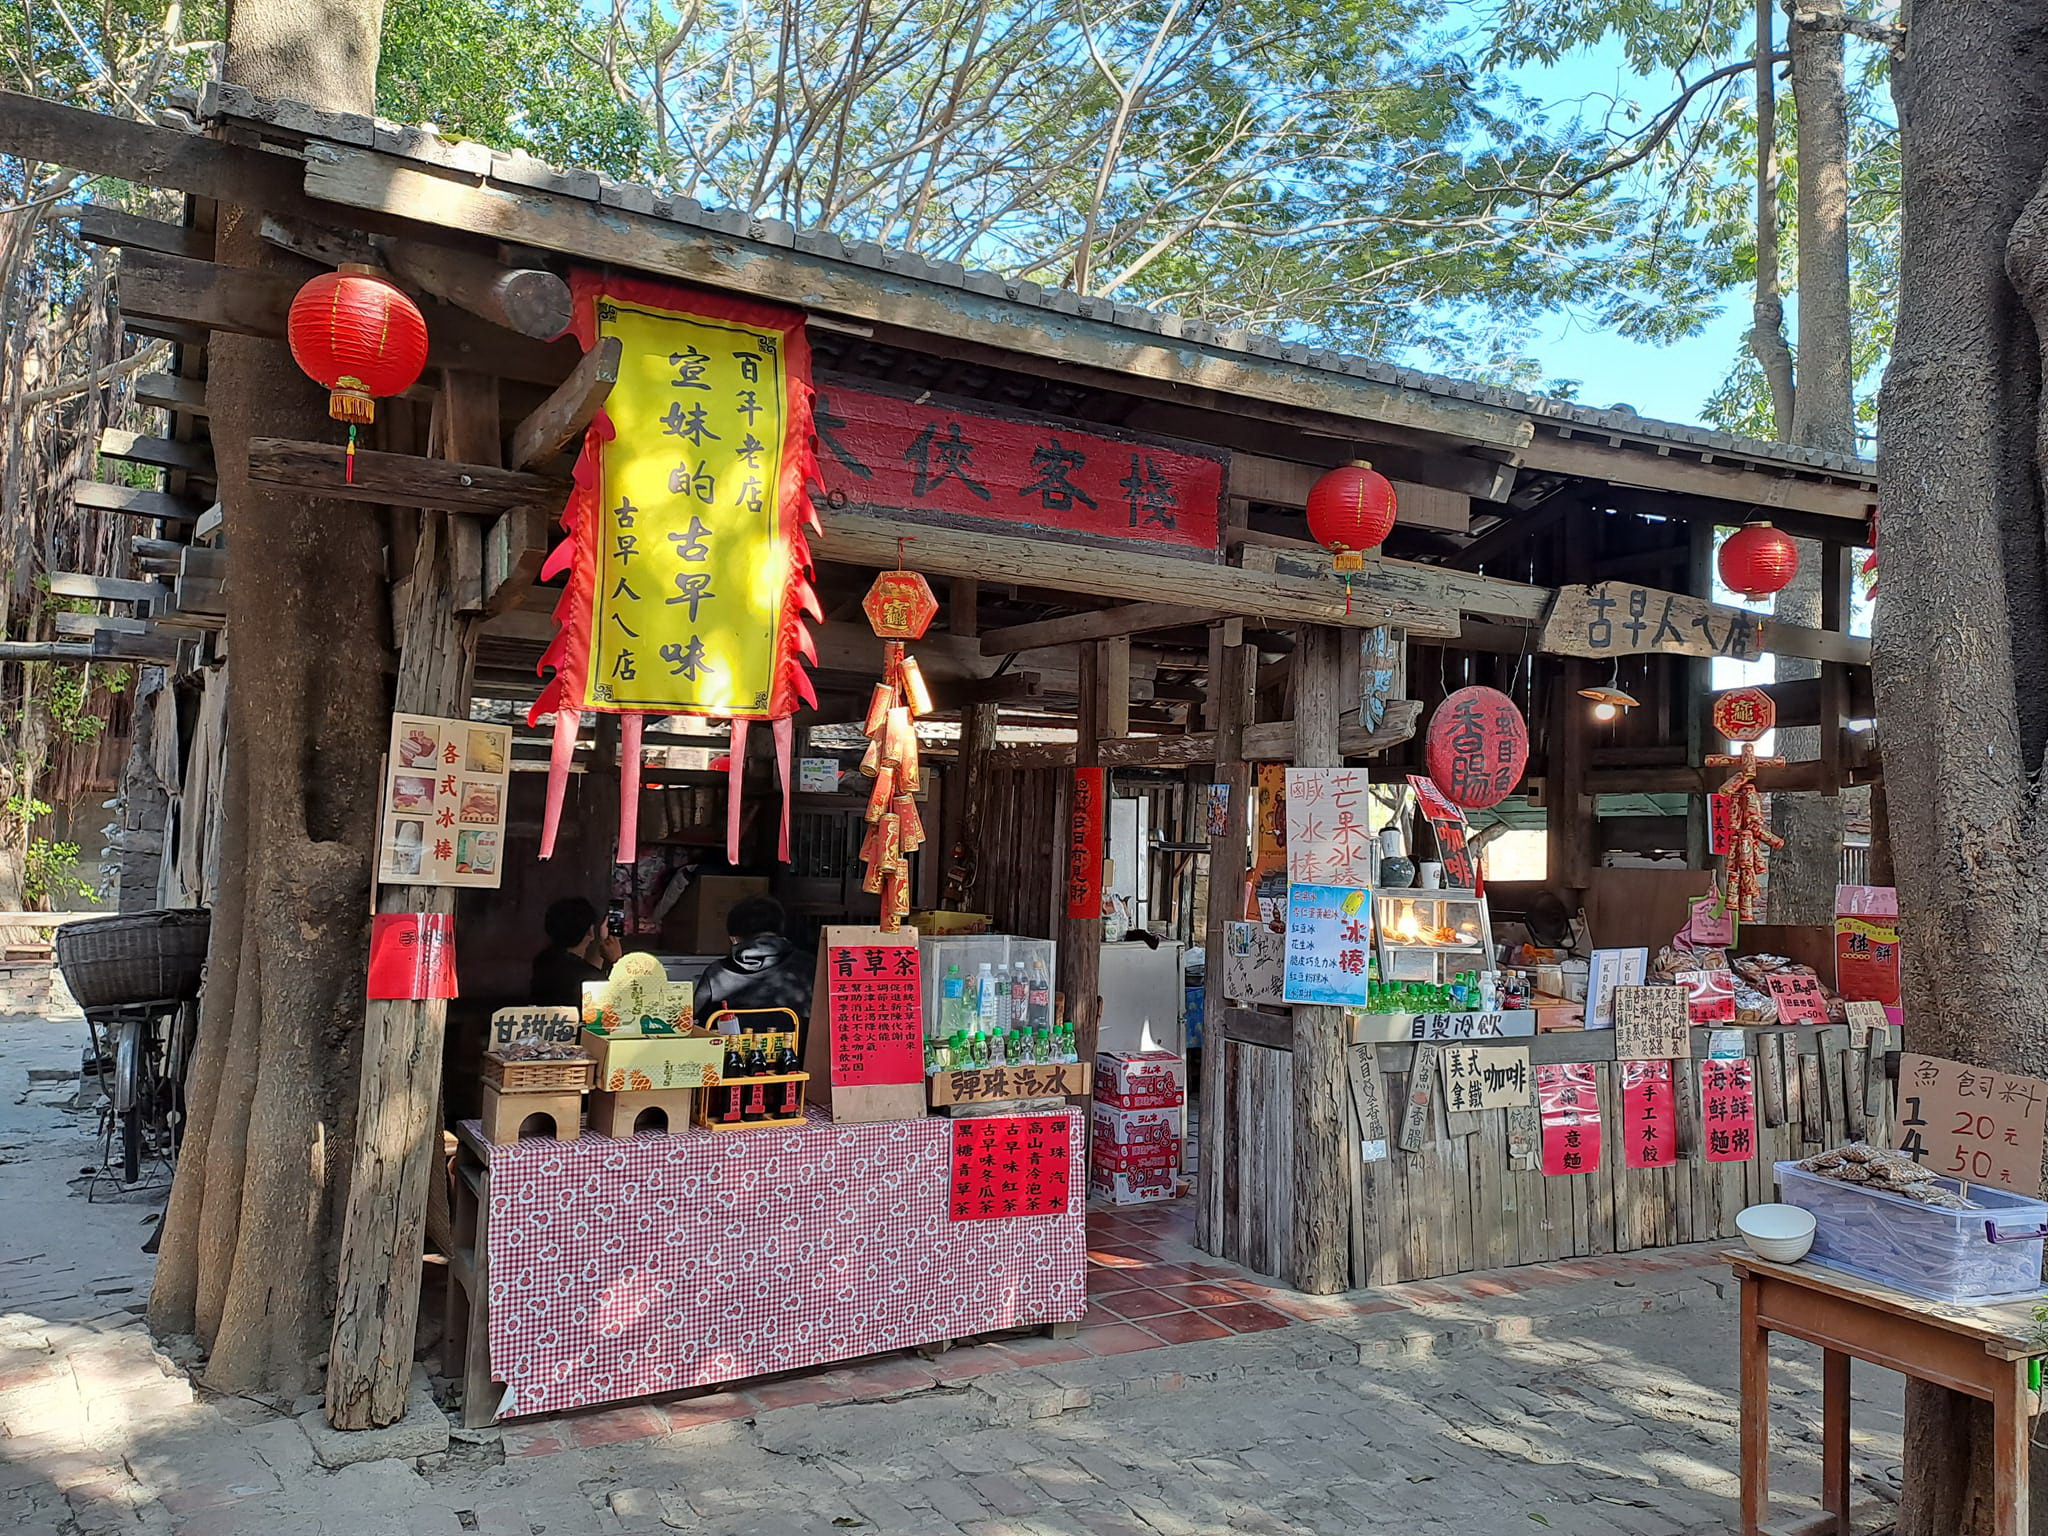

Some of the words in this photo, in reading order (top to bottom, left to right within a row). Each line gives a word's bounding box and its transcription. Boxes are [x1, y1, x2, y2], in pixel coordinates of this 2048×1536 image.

[731, 350, 766, 513] 百年老店
[432, 741, 461, 862] 各式冰棒
[1291, 922, 1316, 935] 紅豆冰
[1291, 939, 1315, 951] 花生冰
[1338, 919, 1367, 977] 冰棒
[832, 949, 917, 977] 青草茶
[1411, 1013, 1504, 1040] 自製冷飲
[950, 1066, 1072, 1101] 彈珠汽水
[1140, 1065, 1162, 1075] ラムネ
[1449, 1049, 1482, 1078] 美式
[1483, 1059, 1527, 1094] 咖啡
[1914, 1059, 2042, 1118] 魚飼料
[1137, 1113, 1158, 1124] ラムネ
[1450, 1080, 1484, 1110] 拿鐵
[1641, 1084, 1660, 1163] 手工水餃
[1707, 1066, 1730, 1155] 海鮮麵
[1729, 1066, 1751, 1154] 海鮮粥
[954, 1124, 974, 1217] 黑糖青草茶
[978, 1123, 998, 1215] 古早味冬瓜茶
[1001, 1122, 1021, 1213] 古早味紅茶
[1025, 1121, 1044, 1211] 高山青冷泡茶
[1048, 1120, 1067, 1210] 彈珠汽水
